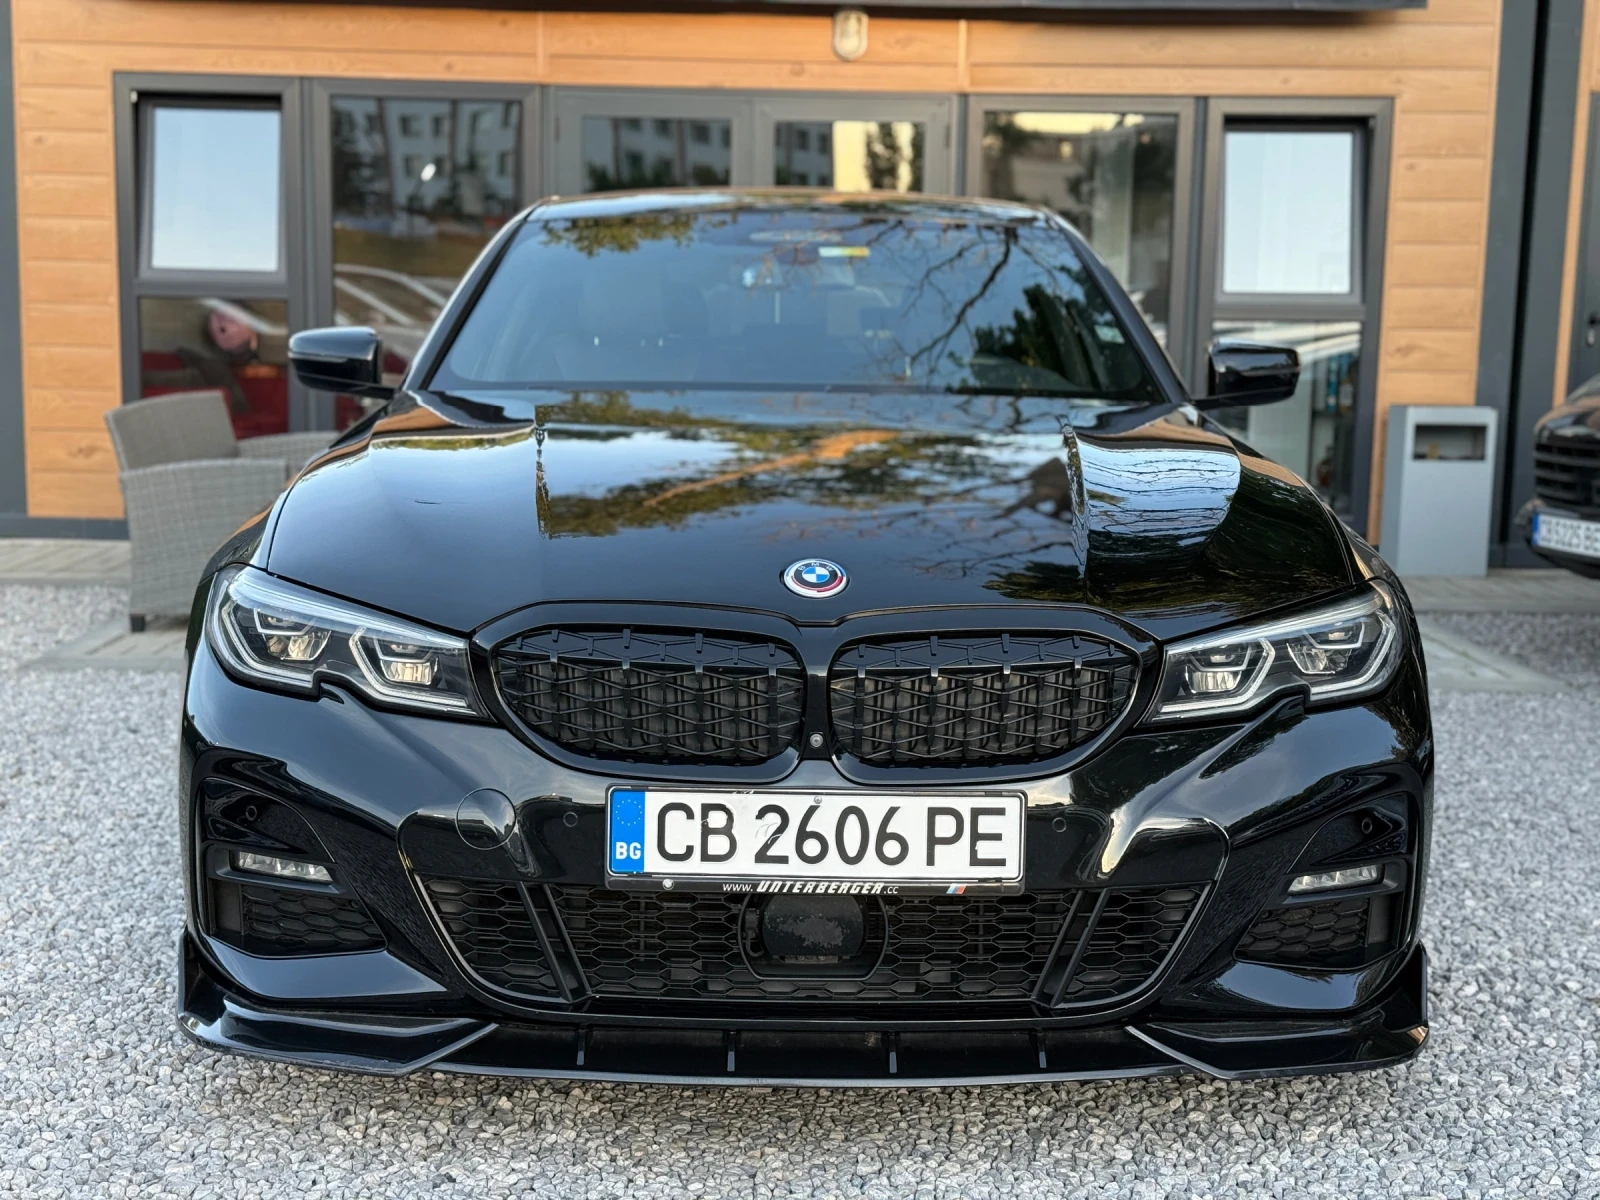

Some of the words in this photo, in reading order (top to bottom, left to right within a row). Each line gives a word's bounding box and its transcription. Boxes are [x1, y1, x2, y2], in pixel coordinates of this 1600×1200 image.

[798, 562, 834, 571] BMW
[657, 802, 737, 862] CB
[754, 804, 909, 865] 2606
[926, 806, 1007, 867] PE
[616, 842, 641, 860] BG
